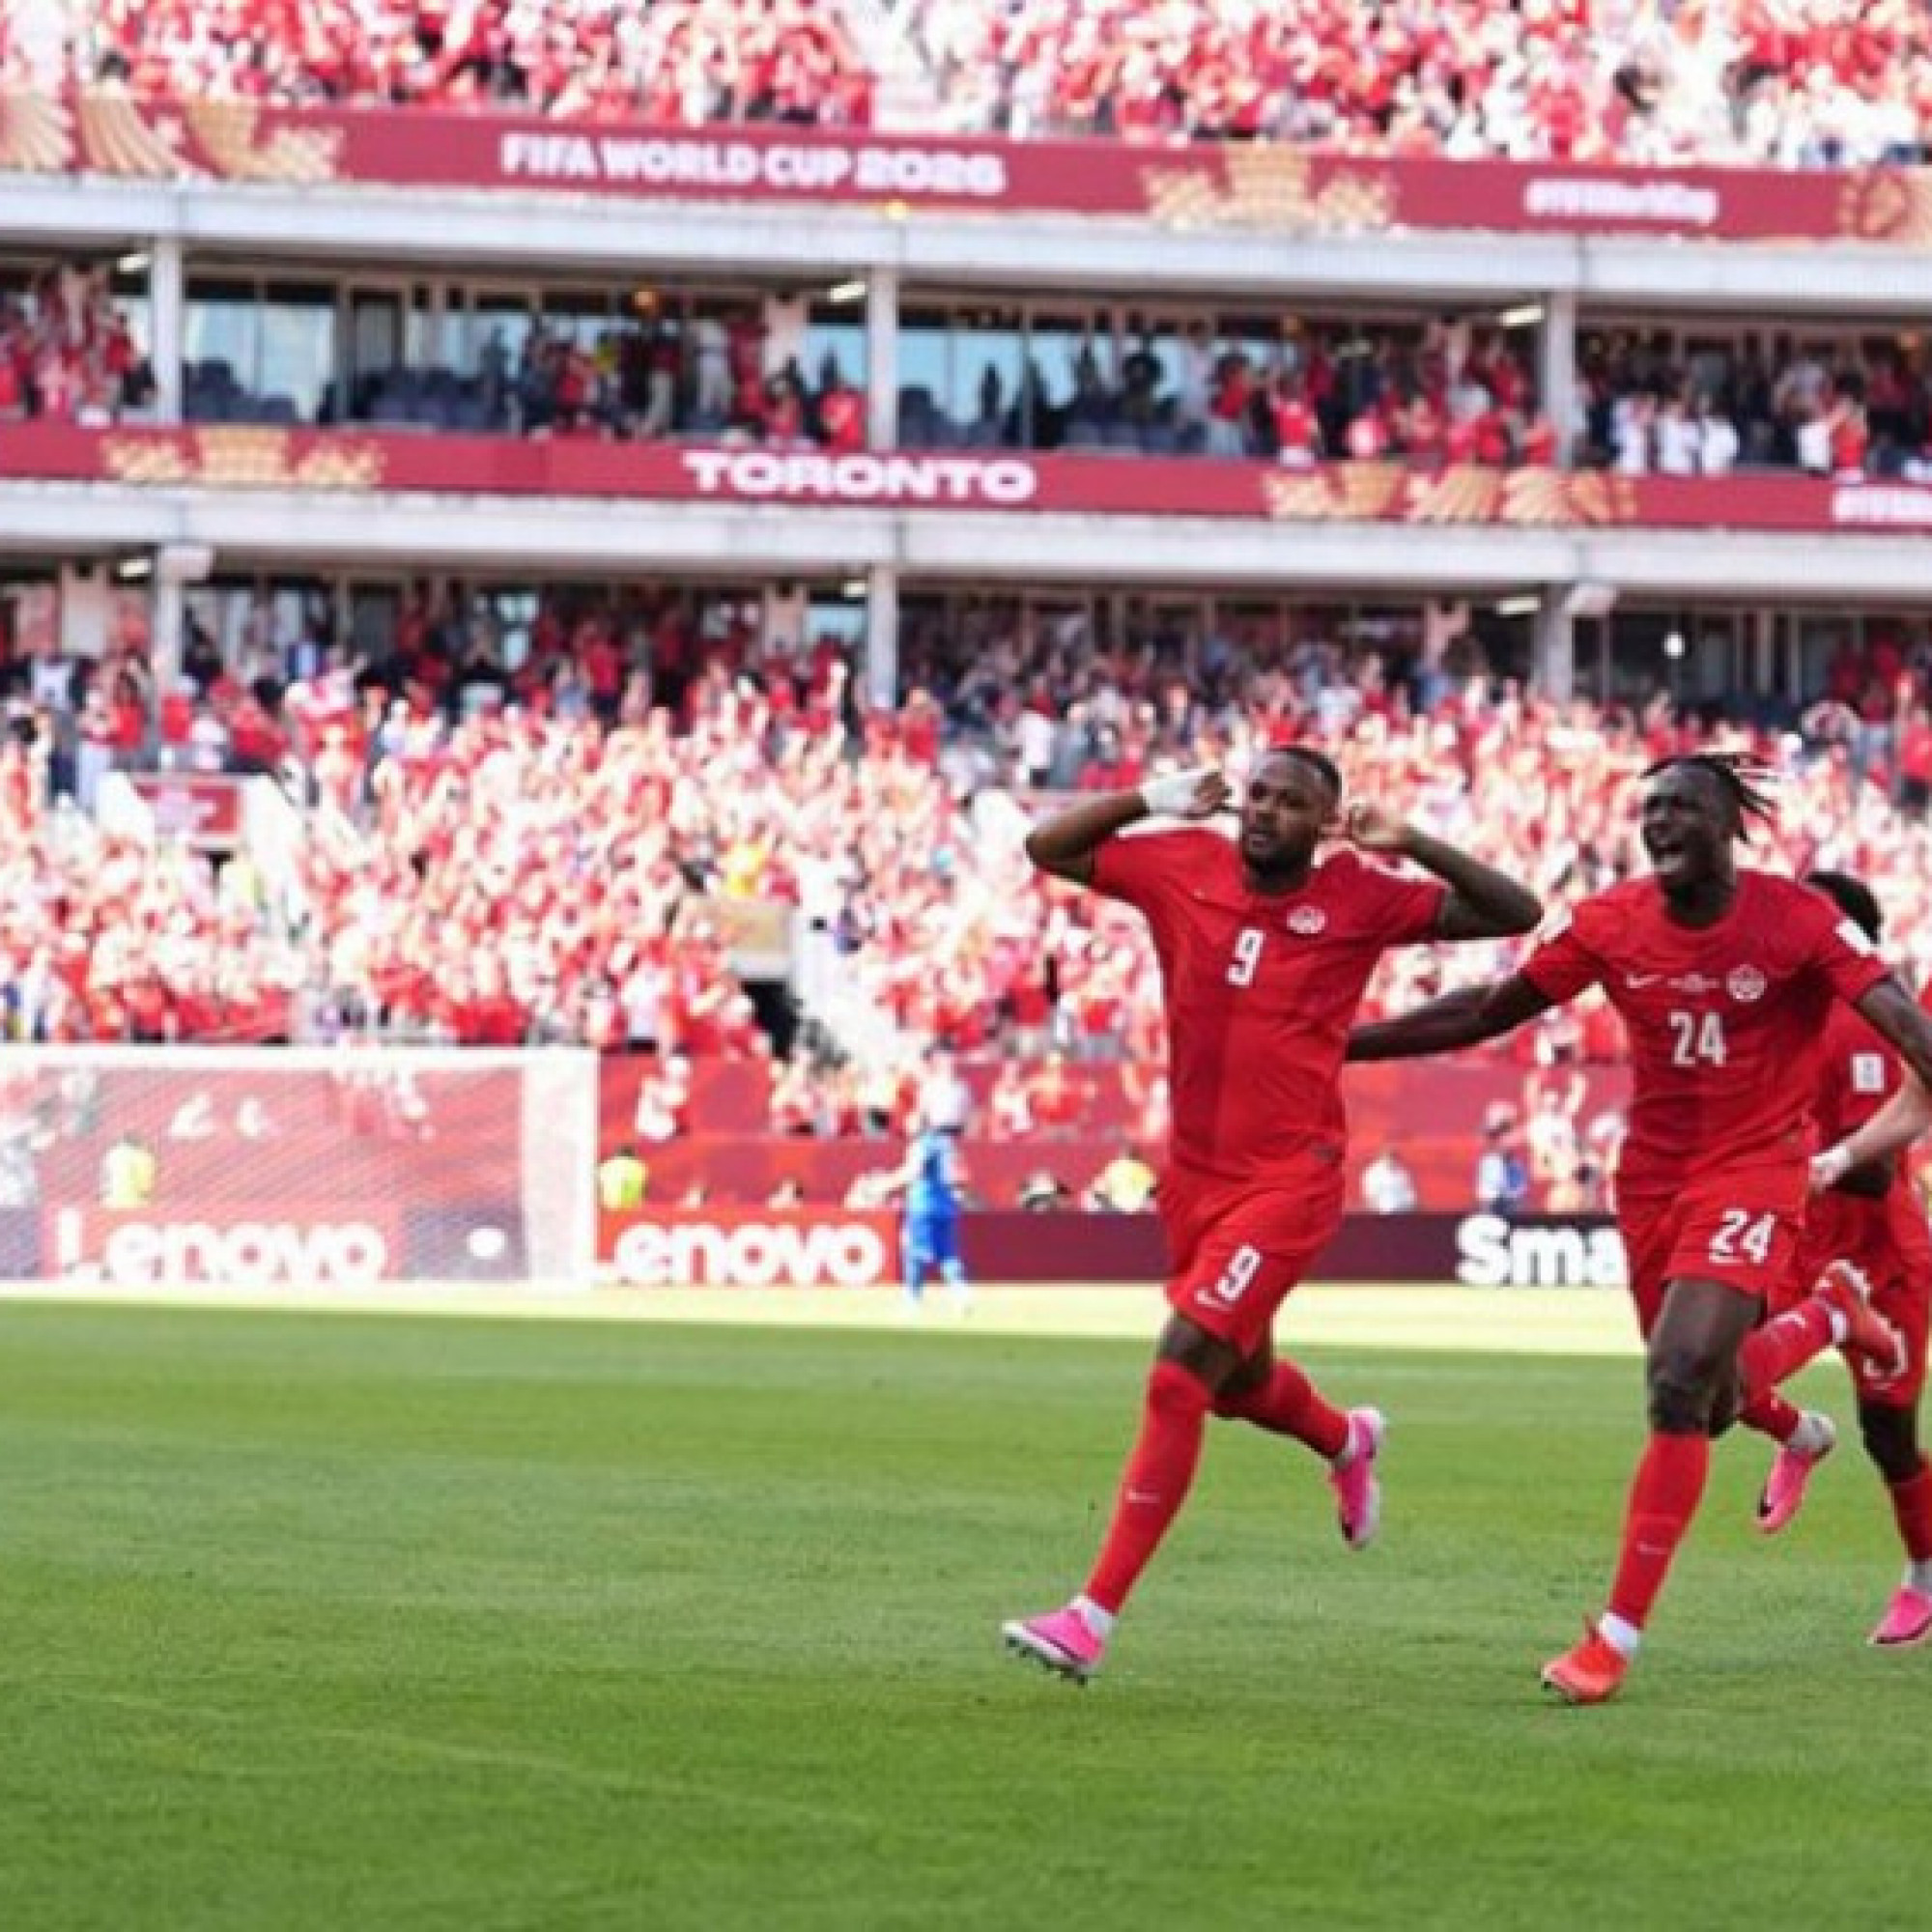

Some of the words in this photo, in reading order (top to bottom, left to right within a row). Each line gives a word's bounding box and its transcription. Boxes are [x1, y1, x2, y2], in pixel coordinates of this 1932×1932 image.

[500, 132, 598, 178] FIFA
[600, 136, 757, 185] WORLD
[762, 144, 851, 189] CUP
[682, 451, 1037, 502] TORONTO
[1227, 928, 1265, 987] 9
[1668, 1009, 1728, 1067] 24
[592, 1222, 885, 1287] enovo
[1709, 1208, 1776, 1264] 24
[1215, 1243, 1261, 1301] 9
